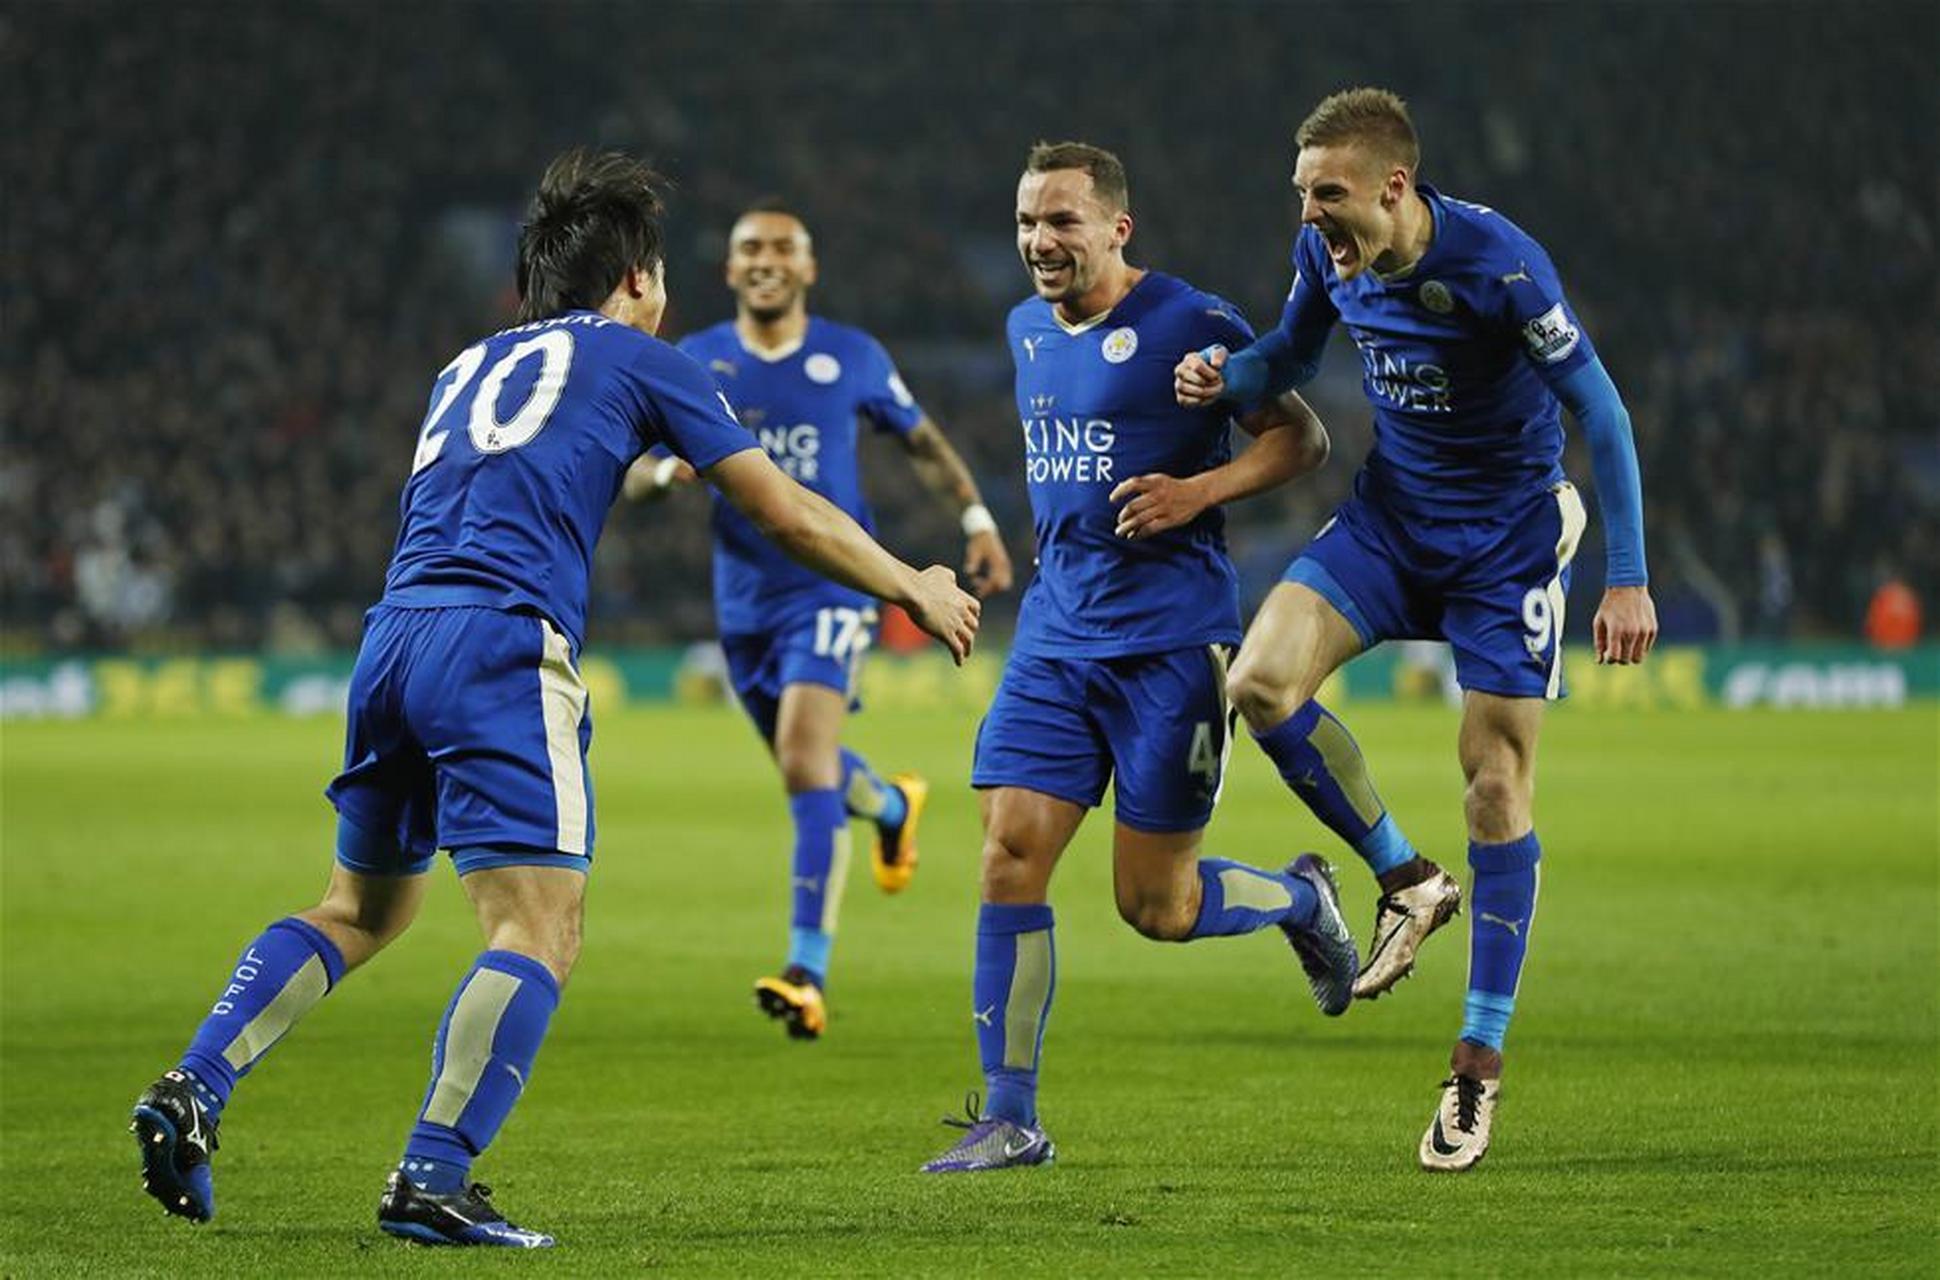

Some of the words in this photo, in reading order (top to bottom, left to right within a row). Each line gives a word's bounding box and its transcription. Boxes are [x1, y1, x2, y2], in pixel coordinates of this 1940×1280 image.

[1362, 348, 1449, 392] ING
[1364, 374, 1452, 412] OWER
[412, 328, 574, 474] 20
[1022, 418, 1115, 453] KING
[1026, 455, 1113, 483] POWER
[814, 606, 861, 659] 17
[1522, 586, 1552, 654] 9
[1187, 720, 1219, 784] 4
